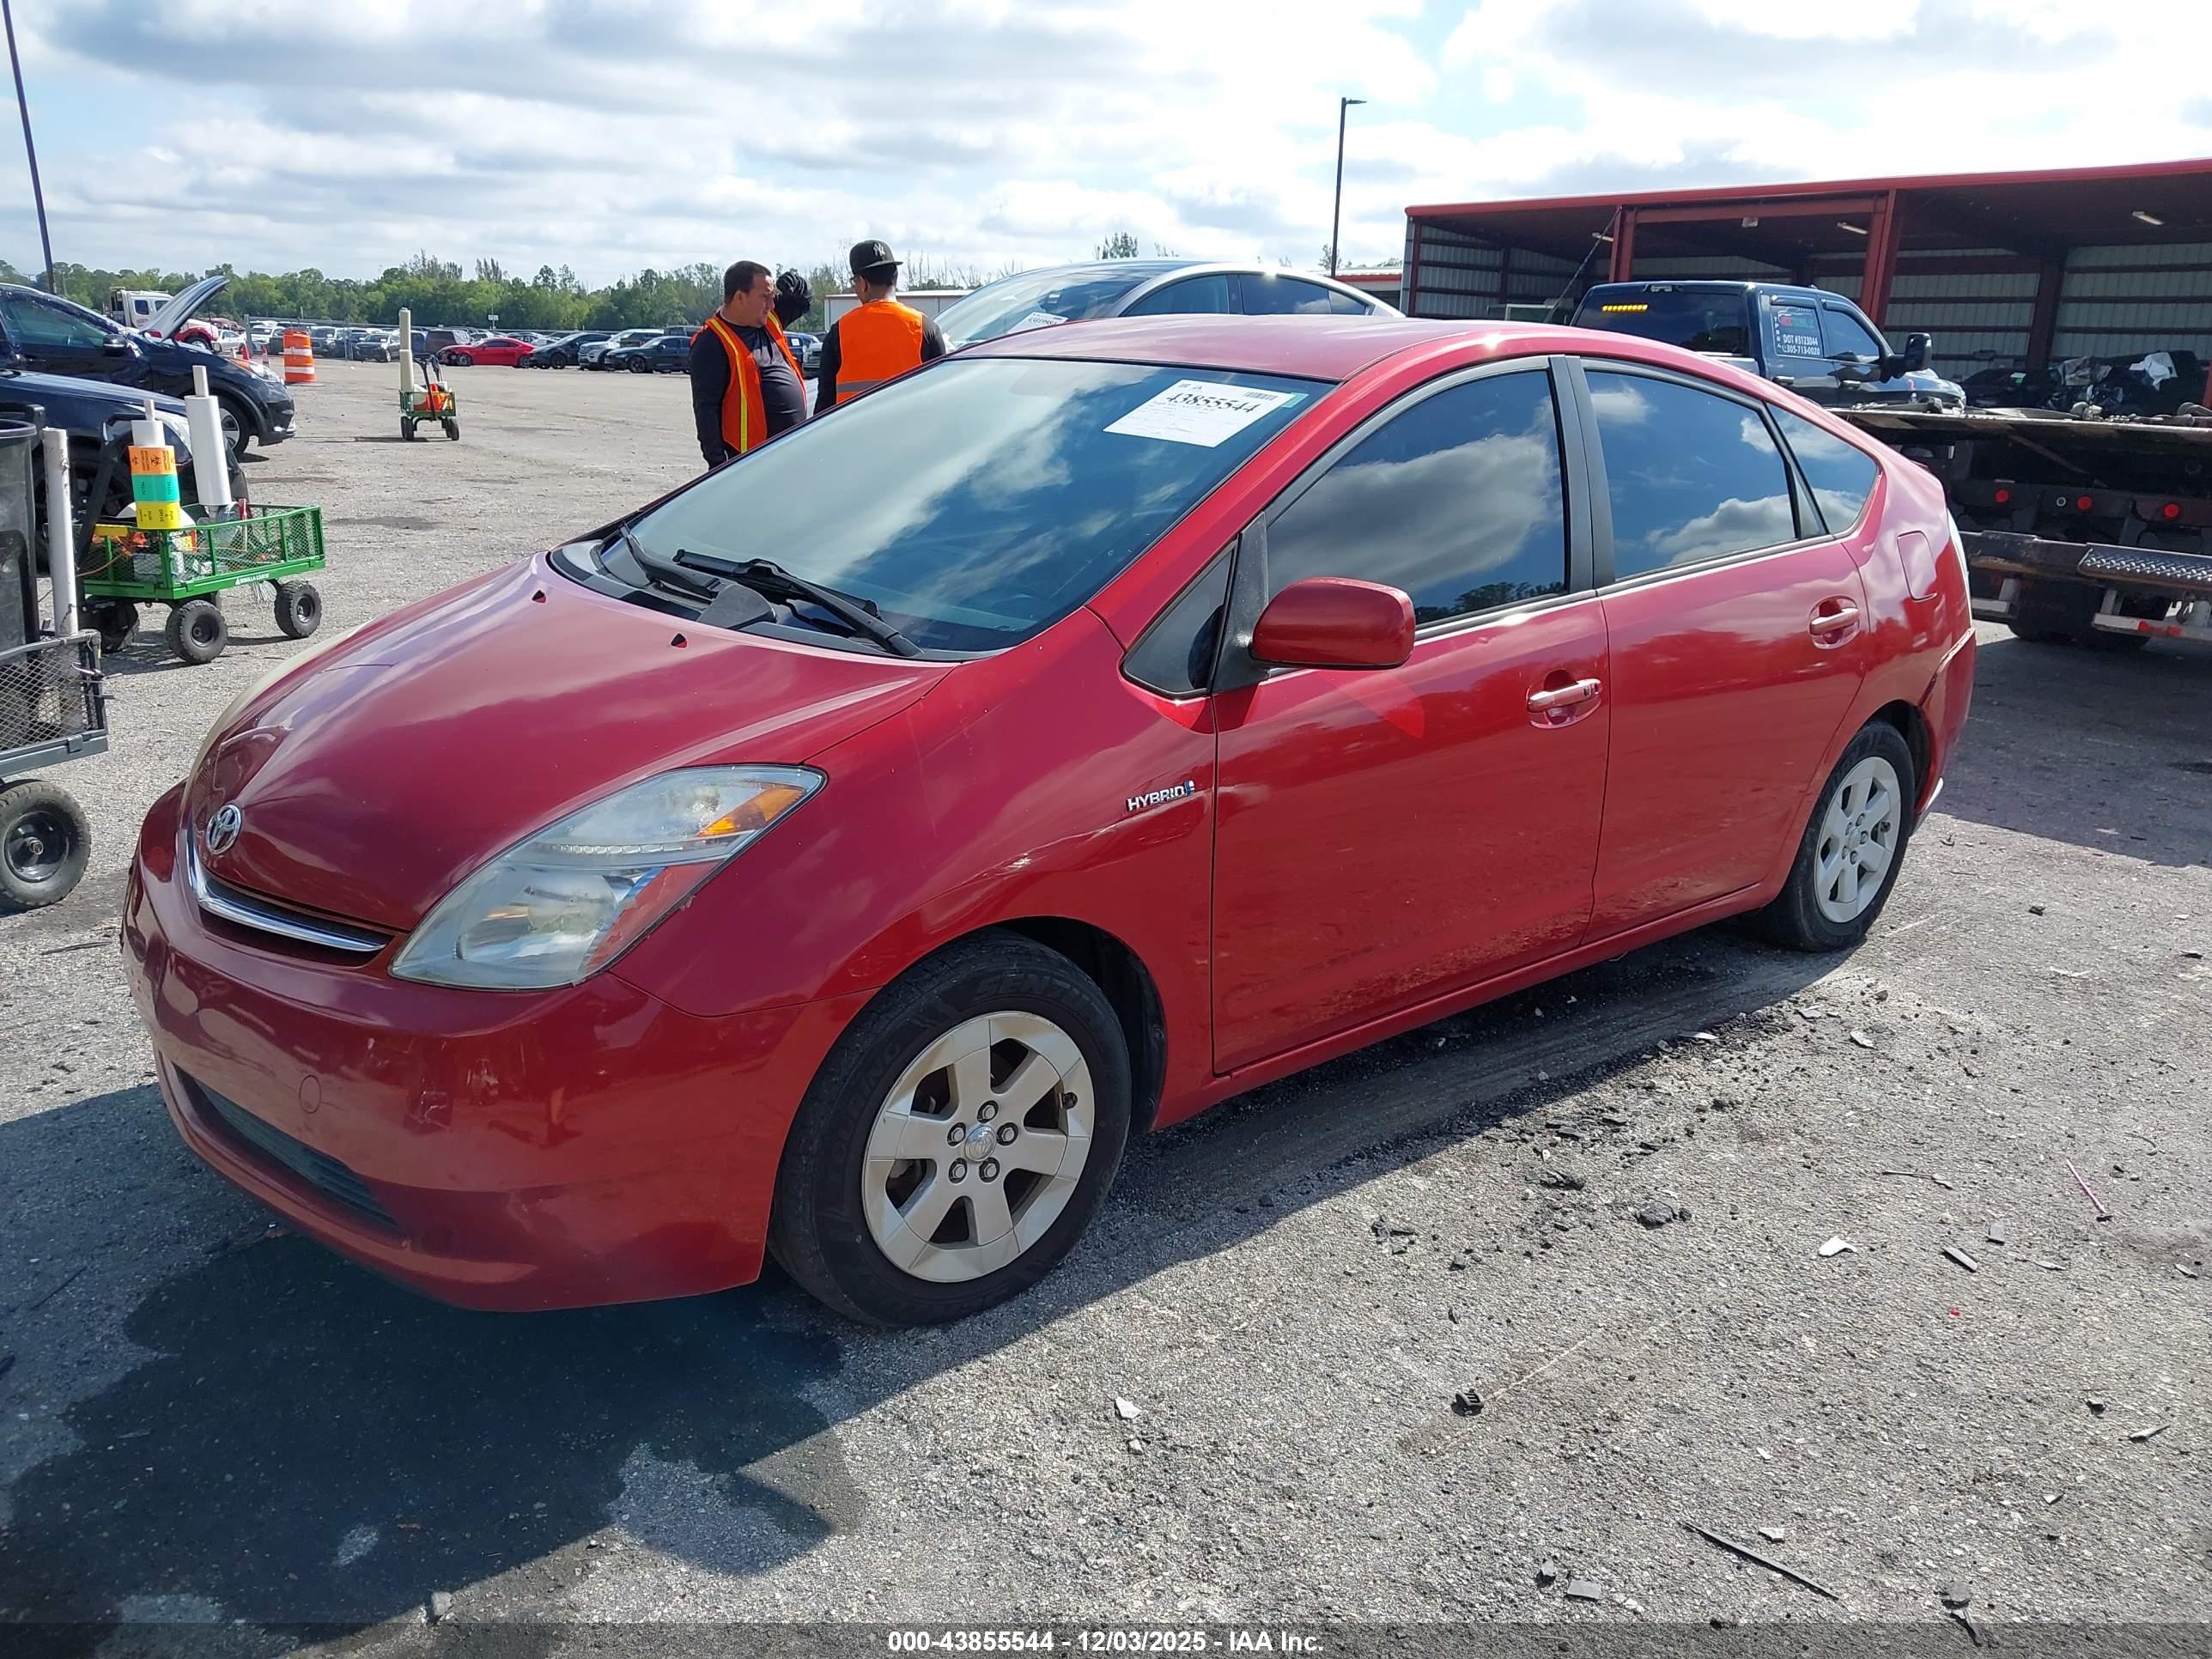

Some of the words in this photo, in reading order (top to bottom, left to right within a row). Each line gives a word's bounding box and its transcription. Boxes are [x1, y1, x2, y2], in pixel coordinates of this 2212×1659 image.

[1783, 334, 1794, 343] DOT
[1166, 392, 1261, 413] 43855544
[1127, 786, 1184, 811] HYBRID
